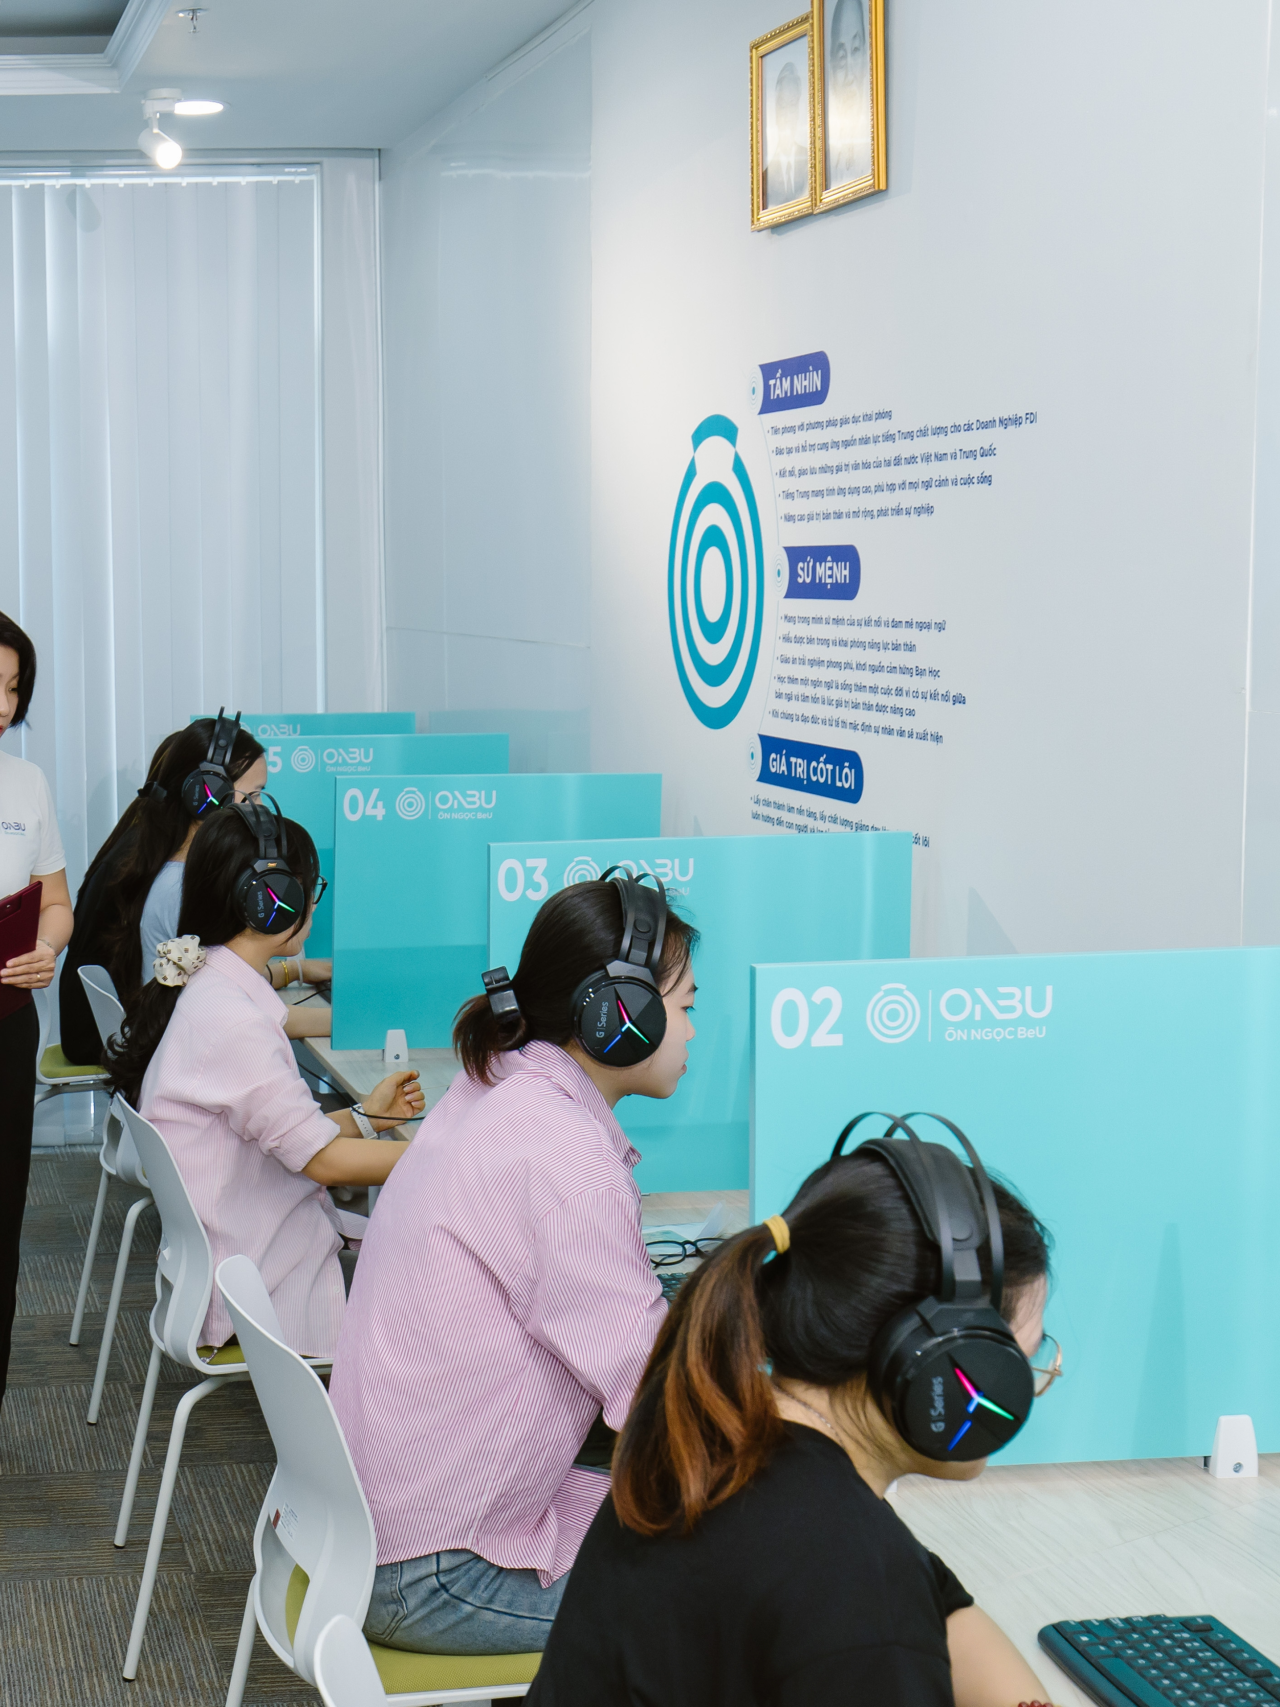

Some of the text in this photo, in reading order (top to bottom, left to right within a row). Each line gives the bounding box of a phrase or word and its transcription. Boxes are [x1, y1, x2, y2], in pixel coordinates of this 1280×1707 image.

[769, 366, 821, 400] TẦM NHÌN
[897, 430, 915, 441] Trung
[916, 425, 930, 438] chất
[950, 422, 962, 433] cho
[962, 420, 974, 432] các
[976, 417, 997, 430] Doanh
[998, 414, 1024, 429] Nghiệp
[1024, 412, 1038, 424] FDI
[920, 452, 932, 465] Việt
[933, 452, 948, 461] Nam
[958, 449, 978, 460] Trung
[979, 444, 997, 457] Quốc
[797, 556, 849, 589] SỨ MỆNH
[928, 667, 941, 680] Học
[769, 749, 854, 789] GIÁ TRỊ CỐT LÕI
[343, 788, 386, 821] 04
[498, 858, 548, 901] 03
[598, 1002, 608, 1027] Series
[770, 986, 843, 1049] 02
[971, 1028, 1015, 1042] NGỌC
[1018, 1026, 1046, 1038] BeU
[930, 1376, 944, 1416] Series
